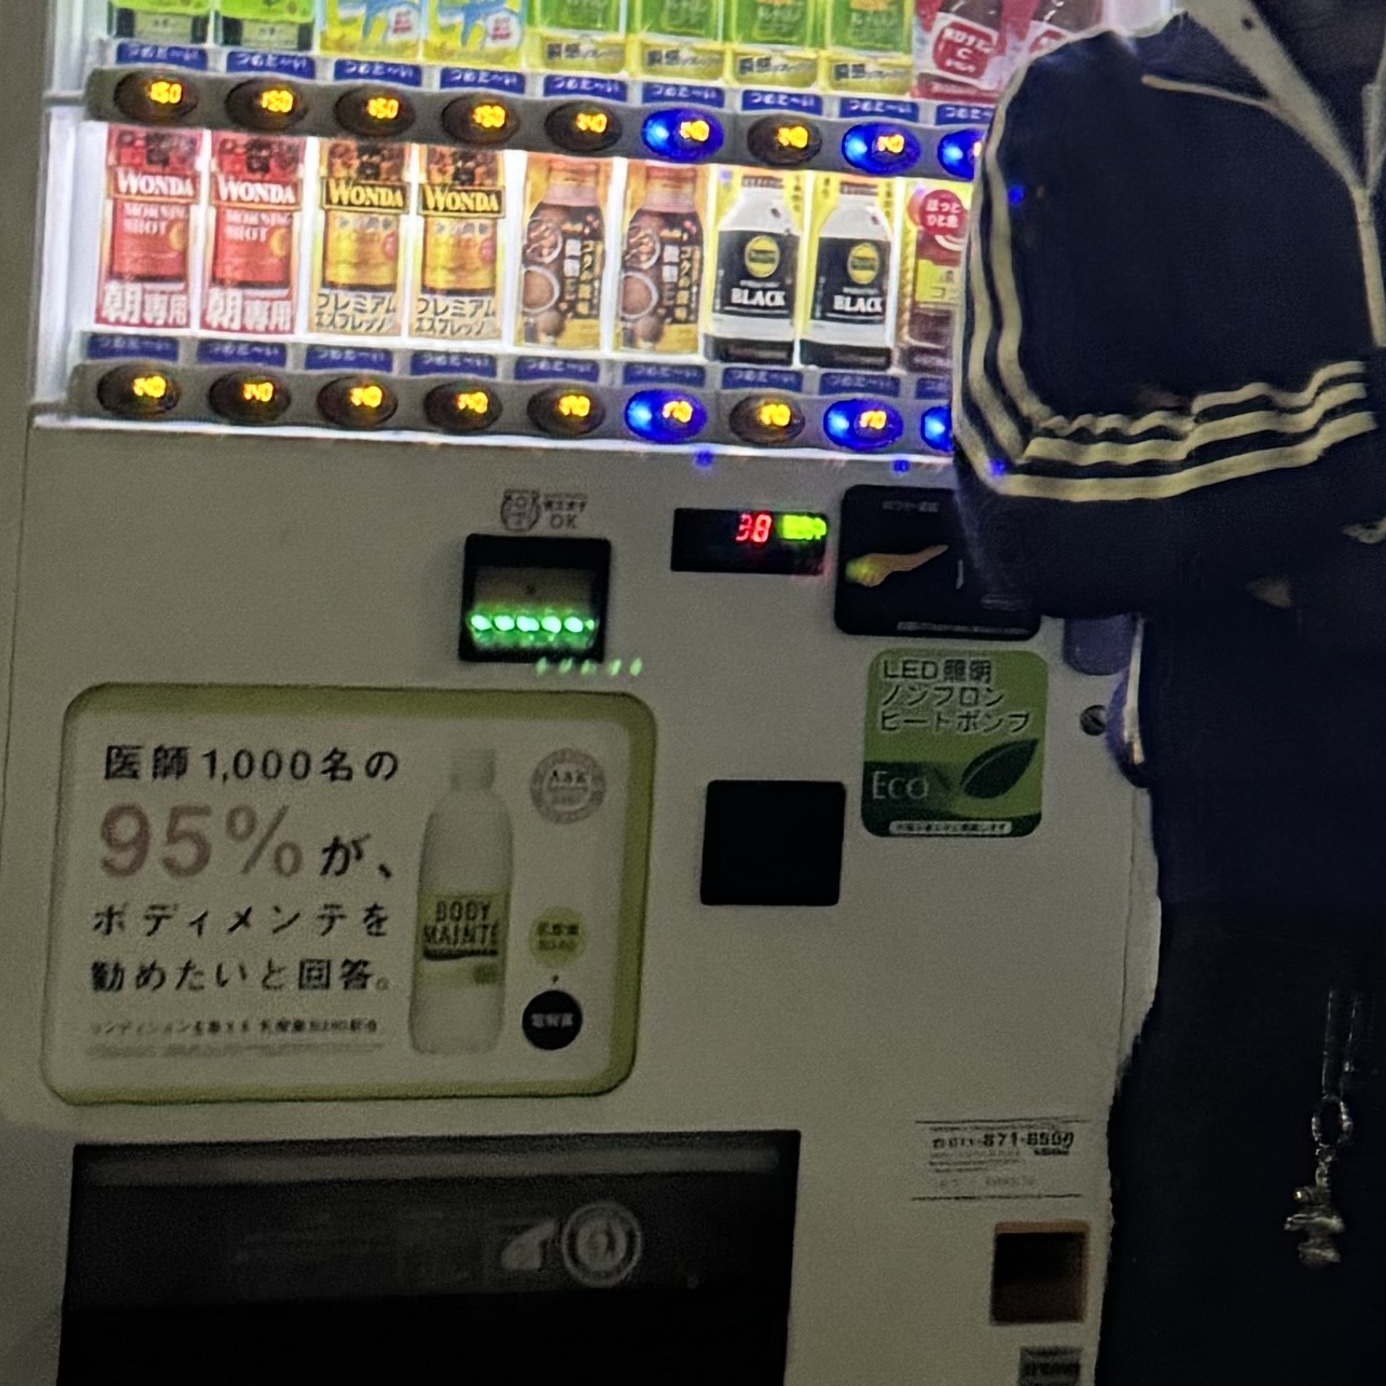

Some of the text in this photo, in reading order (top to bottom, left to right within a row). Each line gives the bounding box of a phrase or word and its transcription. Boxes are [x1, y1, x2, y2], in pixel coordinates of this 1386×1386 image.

[115, 167, 194, 197] WONDA
[217, 174, 295, 204] WONDA
[328, 178, 404, 207] WONDA
[423, 184, 499, 212] WONDA
[730, 288, 786, 307] BLACK
[833, 295, 884, 313] BLACK
[883, 659, 993, 682] LED照明
[881, 685, 1005, 707] ノンフロン
[103, 743, 399, 785] 医師1,000名の
[93, 902, 391, 938] ボディメンテを
[435, 900, 491, 922] BODY
[90, 958, 391, 996] 勧めたいと回答。
